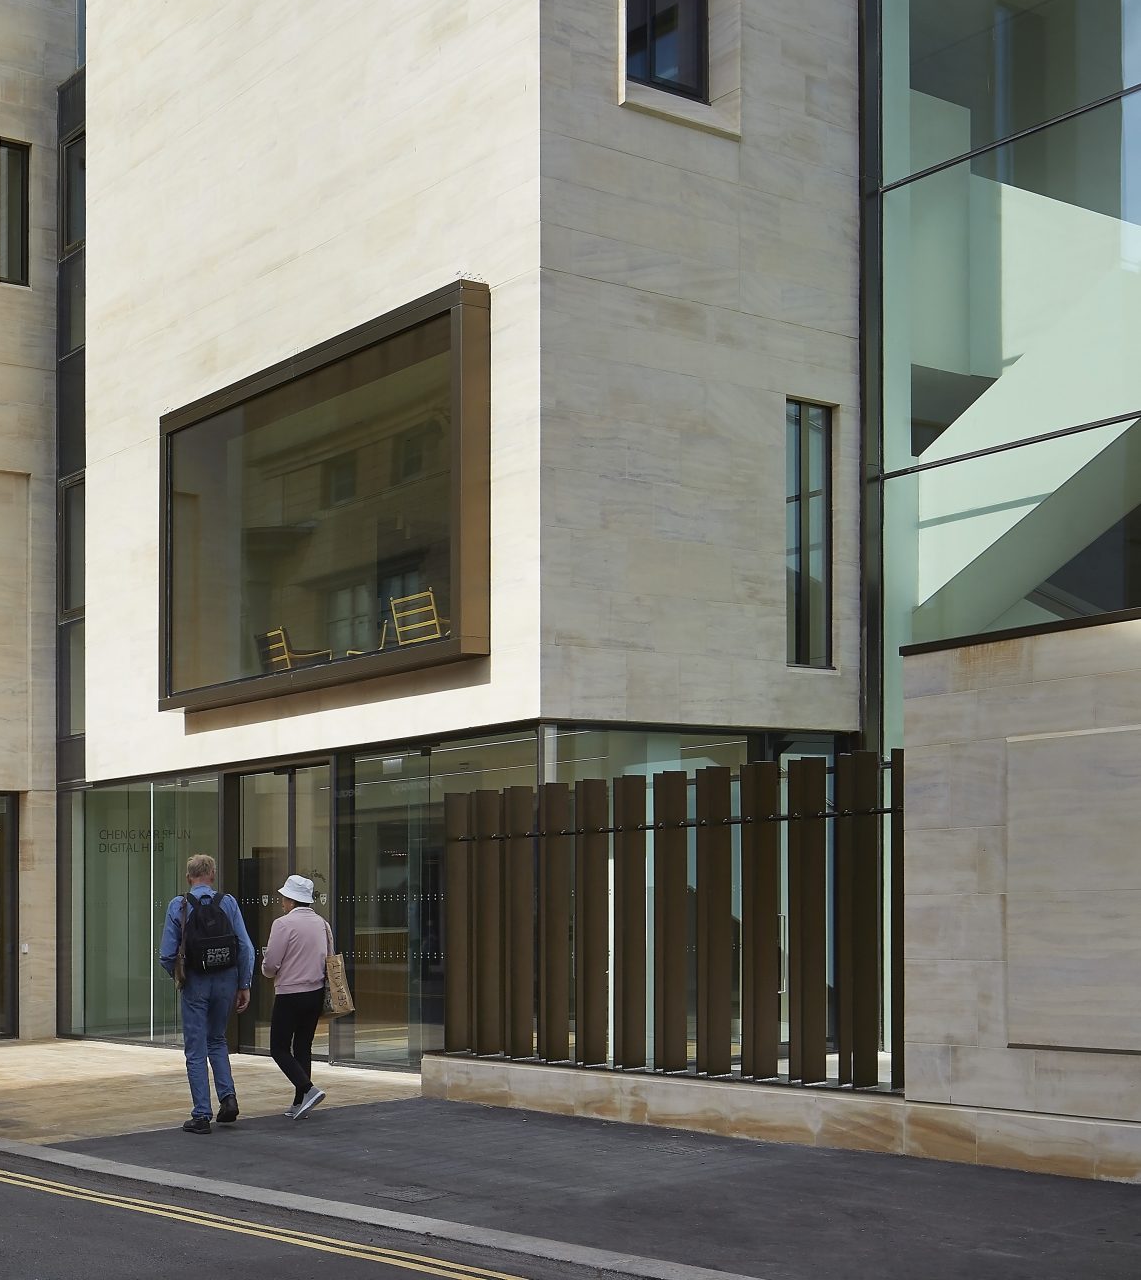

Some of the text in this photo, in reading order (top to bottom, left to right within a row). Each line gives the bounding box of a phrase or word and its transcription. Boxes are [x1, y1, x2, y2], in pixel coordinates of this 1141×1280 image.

[99, 829, 191, 840] CHENG KAR SHUN
[99, 842, 139, 853] DIGITAL
[207, 947, 230, 955] SUPER
